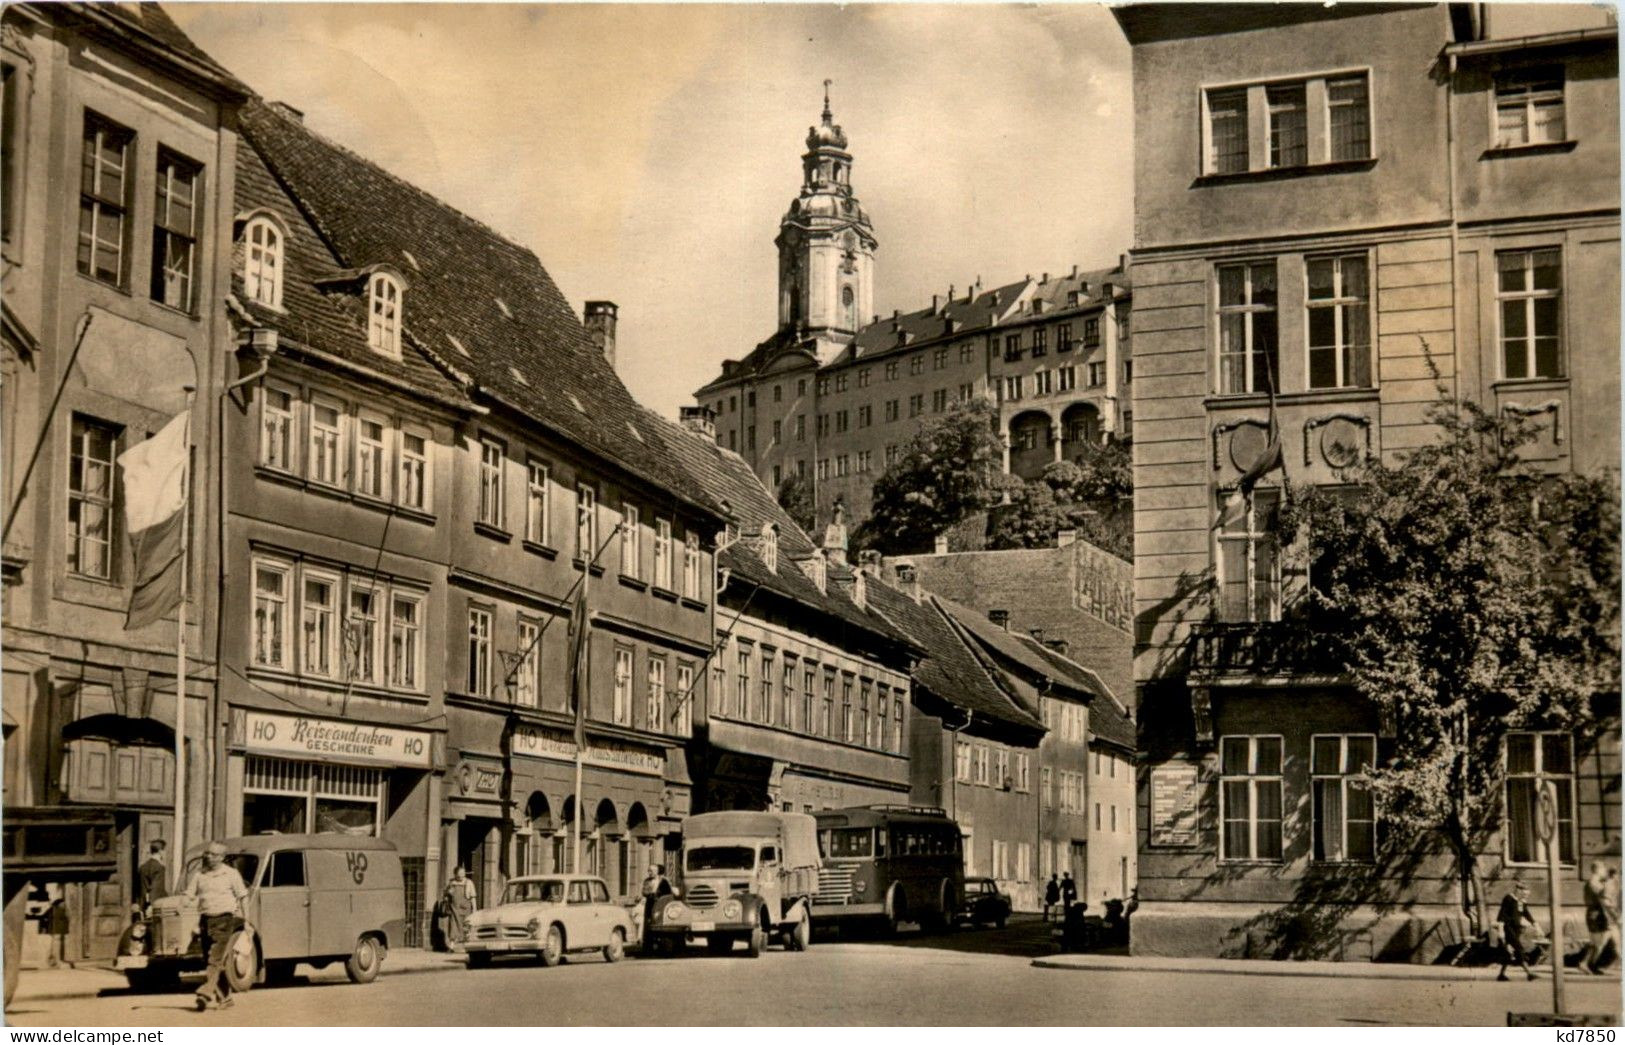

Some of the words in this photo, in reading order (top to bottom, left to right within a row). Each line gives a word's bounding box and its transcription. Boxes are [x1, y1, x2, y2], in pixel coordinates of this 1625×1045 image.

[253, 721, 276, 742] HO
[291, 718, 393, 747] Reiseandenken
[403, 737, 423, 756] HO
[519, 728, 537, 749] HO
[306, 741, 375, 756] GESCHENKE
